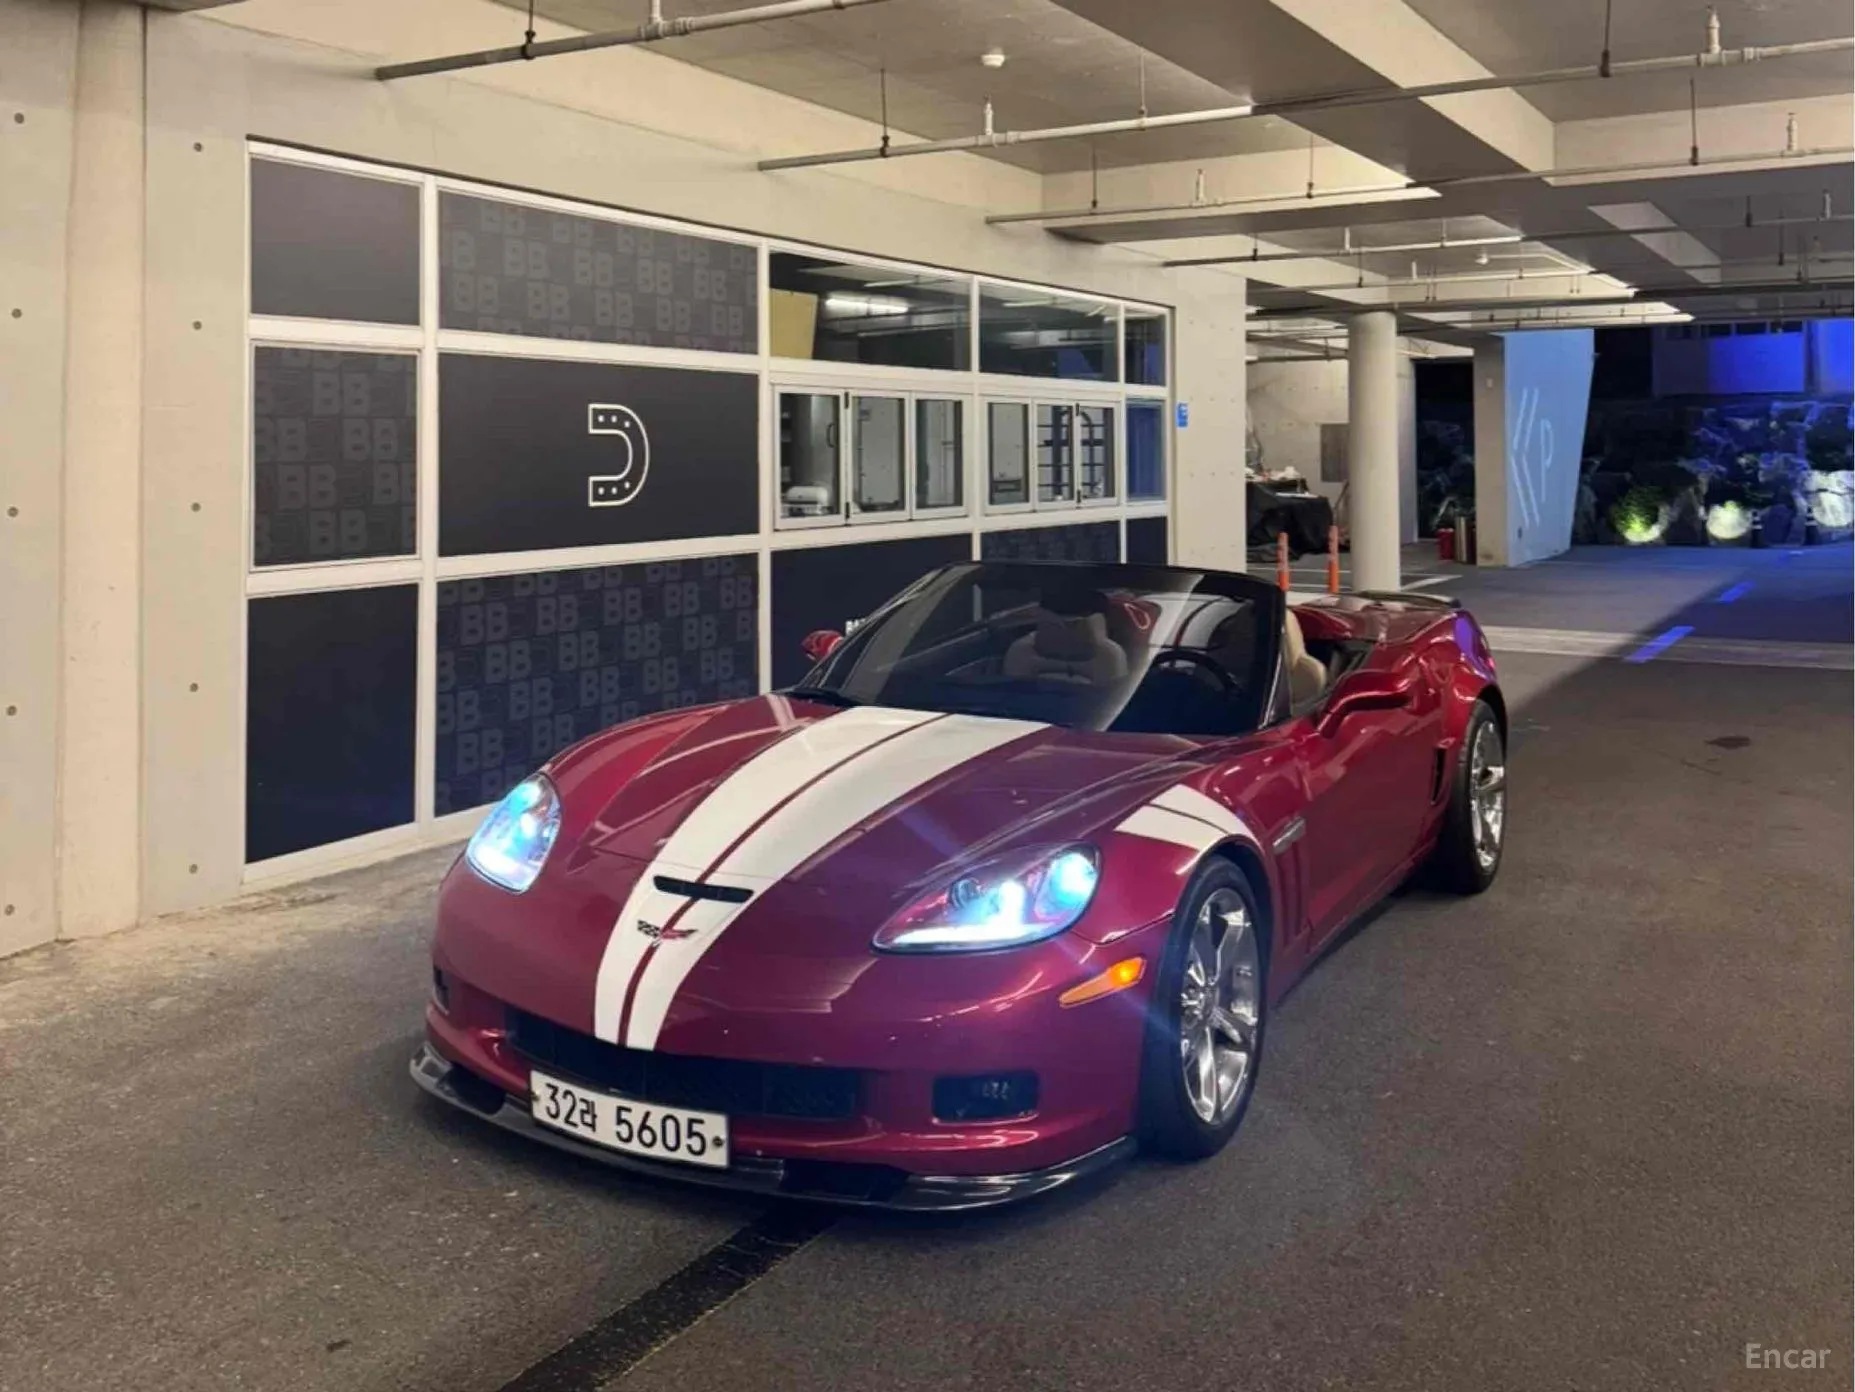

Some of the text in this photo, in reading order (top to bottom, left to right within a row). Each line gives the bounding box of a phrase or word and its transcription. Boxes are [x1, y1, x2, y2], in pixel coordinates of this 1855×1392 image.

[504, 239, 549, 280] BB
[453, 273, 498, 314] BB
[527, 281, 571, 321] BB
[595, 289, 634, 328] BB
[656, 296, 691, 332] BB
[711, 303, 743, 336] BB
[313, 373, 371, 416] BB
[344, 418, 399, 460] BB
[278, 464, 338, 509] BB
[309, 509, 368, 555] BB
[604, 587, 642, 625] BB
[665, 581, 699, 617] BB
[720, 576, 752, 610] BB
[461, 602, 508, 646] BB
[536, 594, 578, 636] BB
[683, 614, 717, 651] BB
[486, 638, 532, 684] BB
[558, 630, 599, 671] BB
[624, 621, 661, 661] BB
[643, 656, 679, 695] BB
[702, 647, 734, 683] BB
[509, 677, 554, 721] BB
[580, 666, 619, 707] BB
[457, 728, 503, 777] BB
[545, 1083, 707, 1157] 32라 5605
